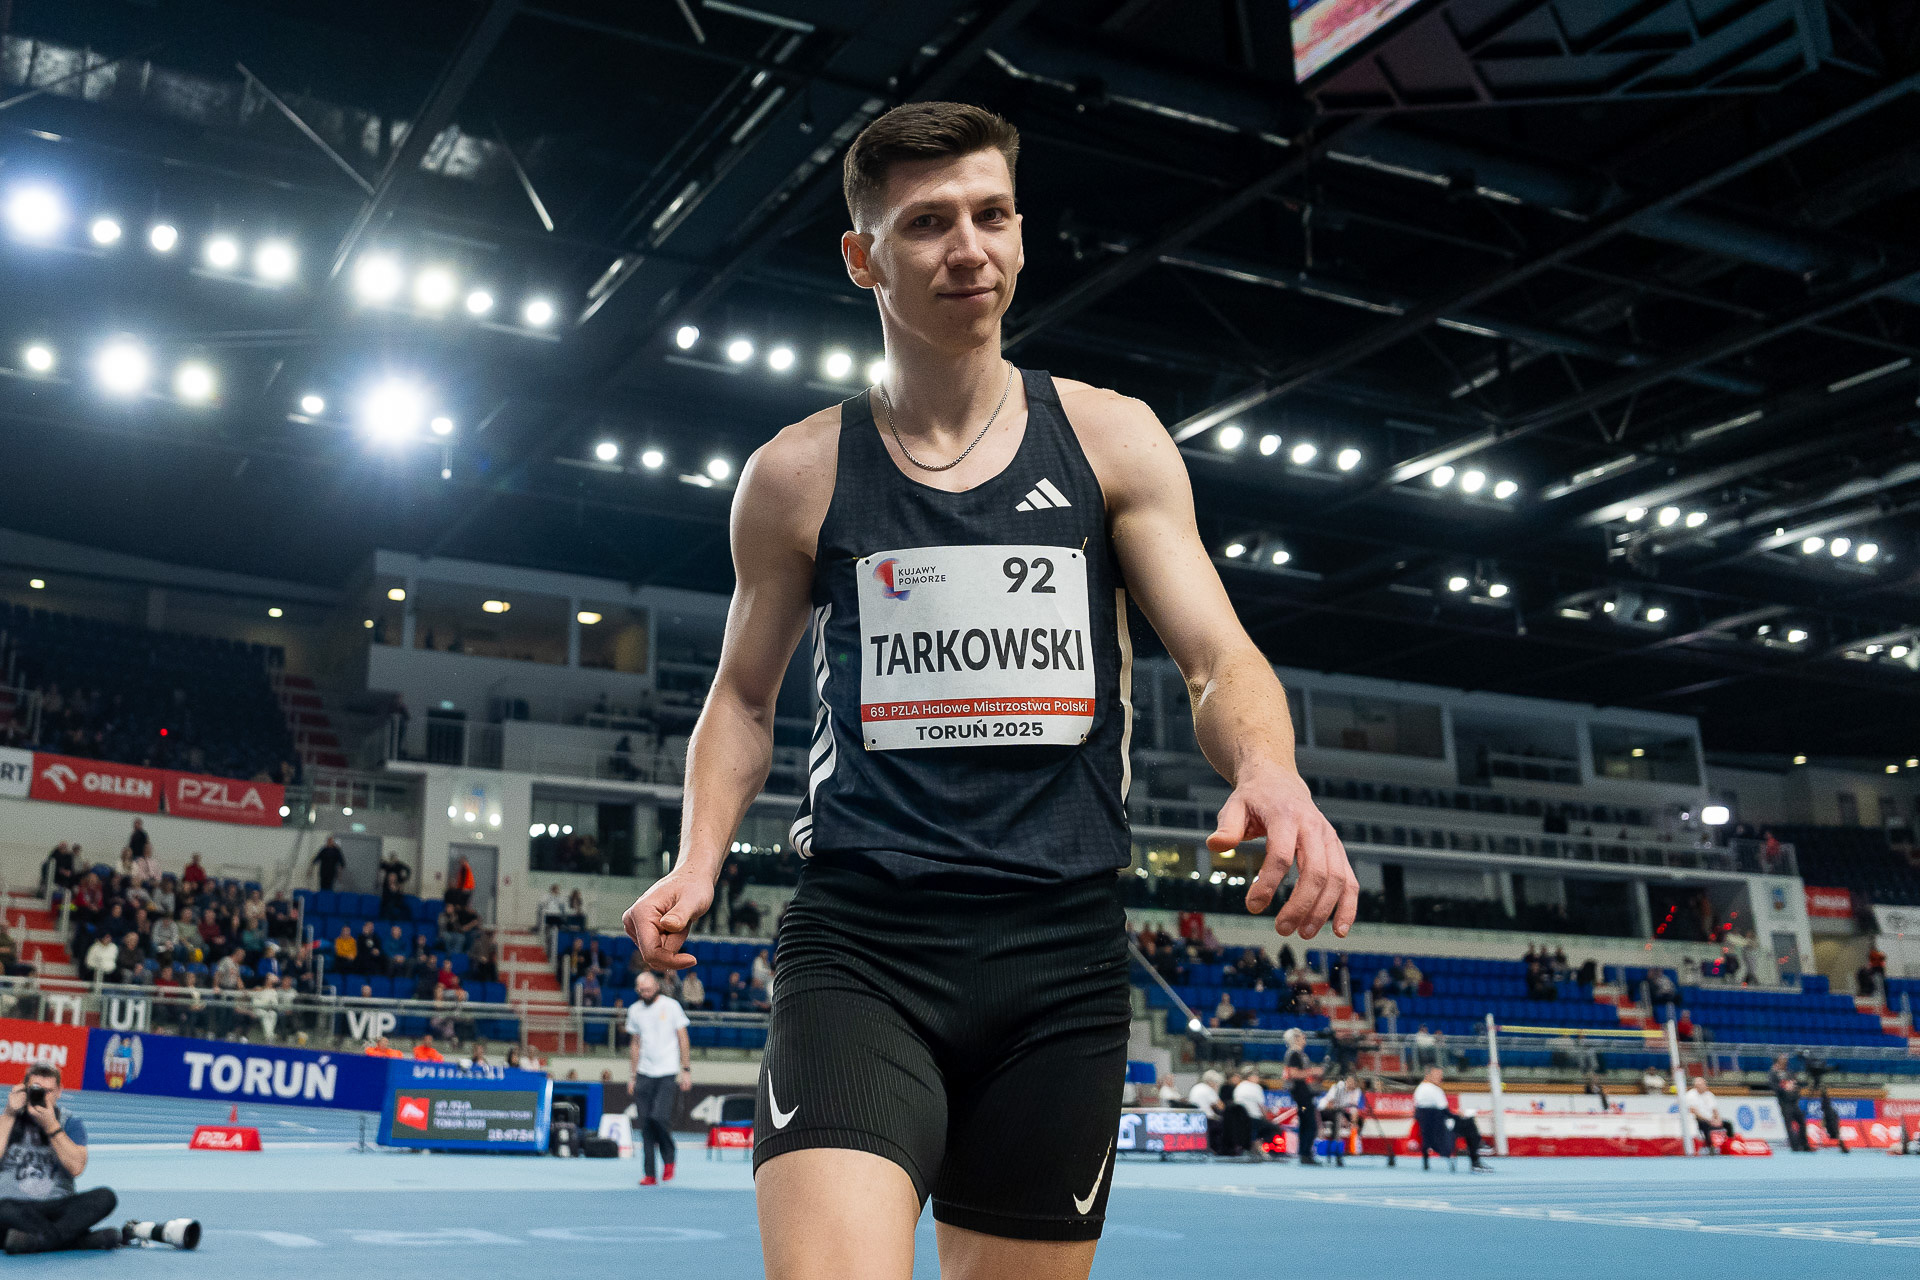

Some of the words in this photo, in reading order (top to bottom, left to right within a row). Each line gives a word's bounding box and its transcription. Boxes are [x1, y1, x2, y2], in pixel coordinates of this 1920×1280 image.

[898, 566, 936, 576] KUJAWY
[898, 575, 946, 585] POMORZE
[1003, 557, 1056, 593] 92
[870, 628, 1085, 676] TARKOWSKI
[870, 707, 888, 718] 69.
[891, 705, 919, 717] PZLA
[923, 703, 970, 715] Halowe
[974, 701, 1051, 713] Mistrzostwa
[1054, 701, 1088, 712] Polski
[916, 719, 987, 740] TORUŃ
[993, 722, 1043, 737] 2025
[82, 772, 153, 798] ORLEN
[177, 778, 265, 811] PZLA
[110, 998, 146, 1031] U1
[347, 1010, 396, 1040] VIP
[183, 1051, 337, 1101] TORUŃ
